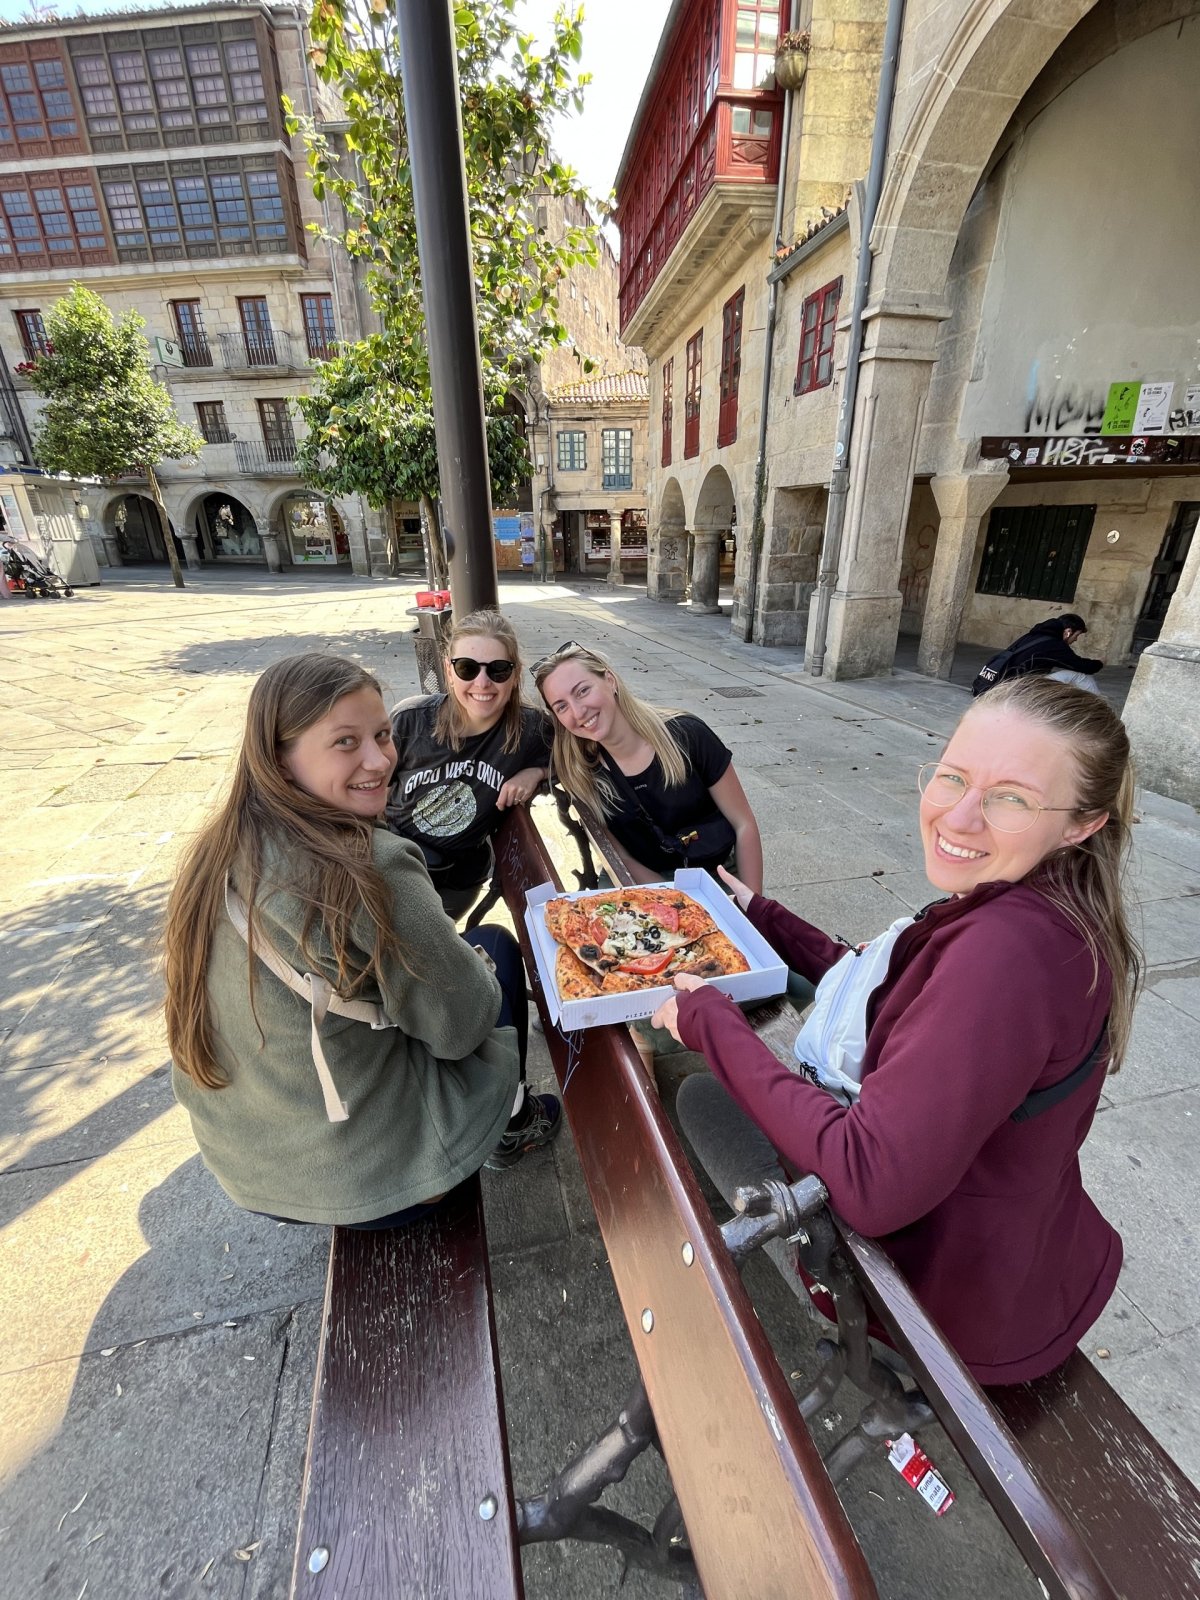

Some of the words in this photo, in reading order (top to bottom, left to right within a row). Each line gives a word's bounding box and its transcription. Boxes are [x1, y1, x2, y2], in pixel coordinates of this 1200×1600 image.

[979, 665, 998, 682] VANS
[405, 766, 442, 795] GOOD
[477, 760, 505, 792] ONLY
[625, 1010, 656, 1020] PIZZERI
[919, 1474, 935, 1495] Fumar
[930, 1484, 942, 1502] mata
